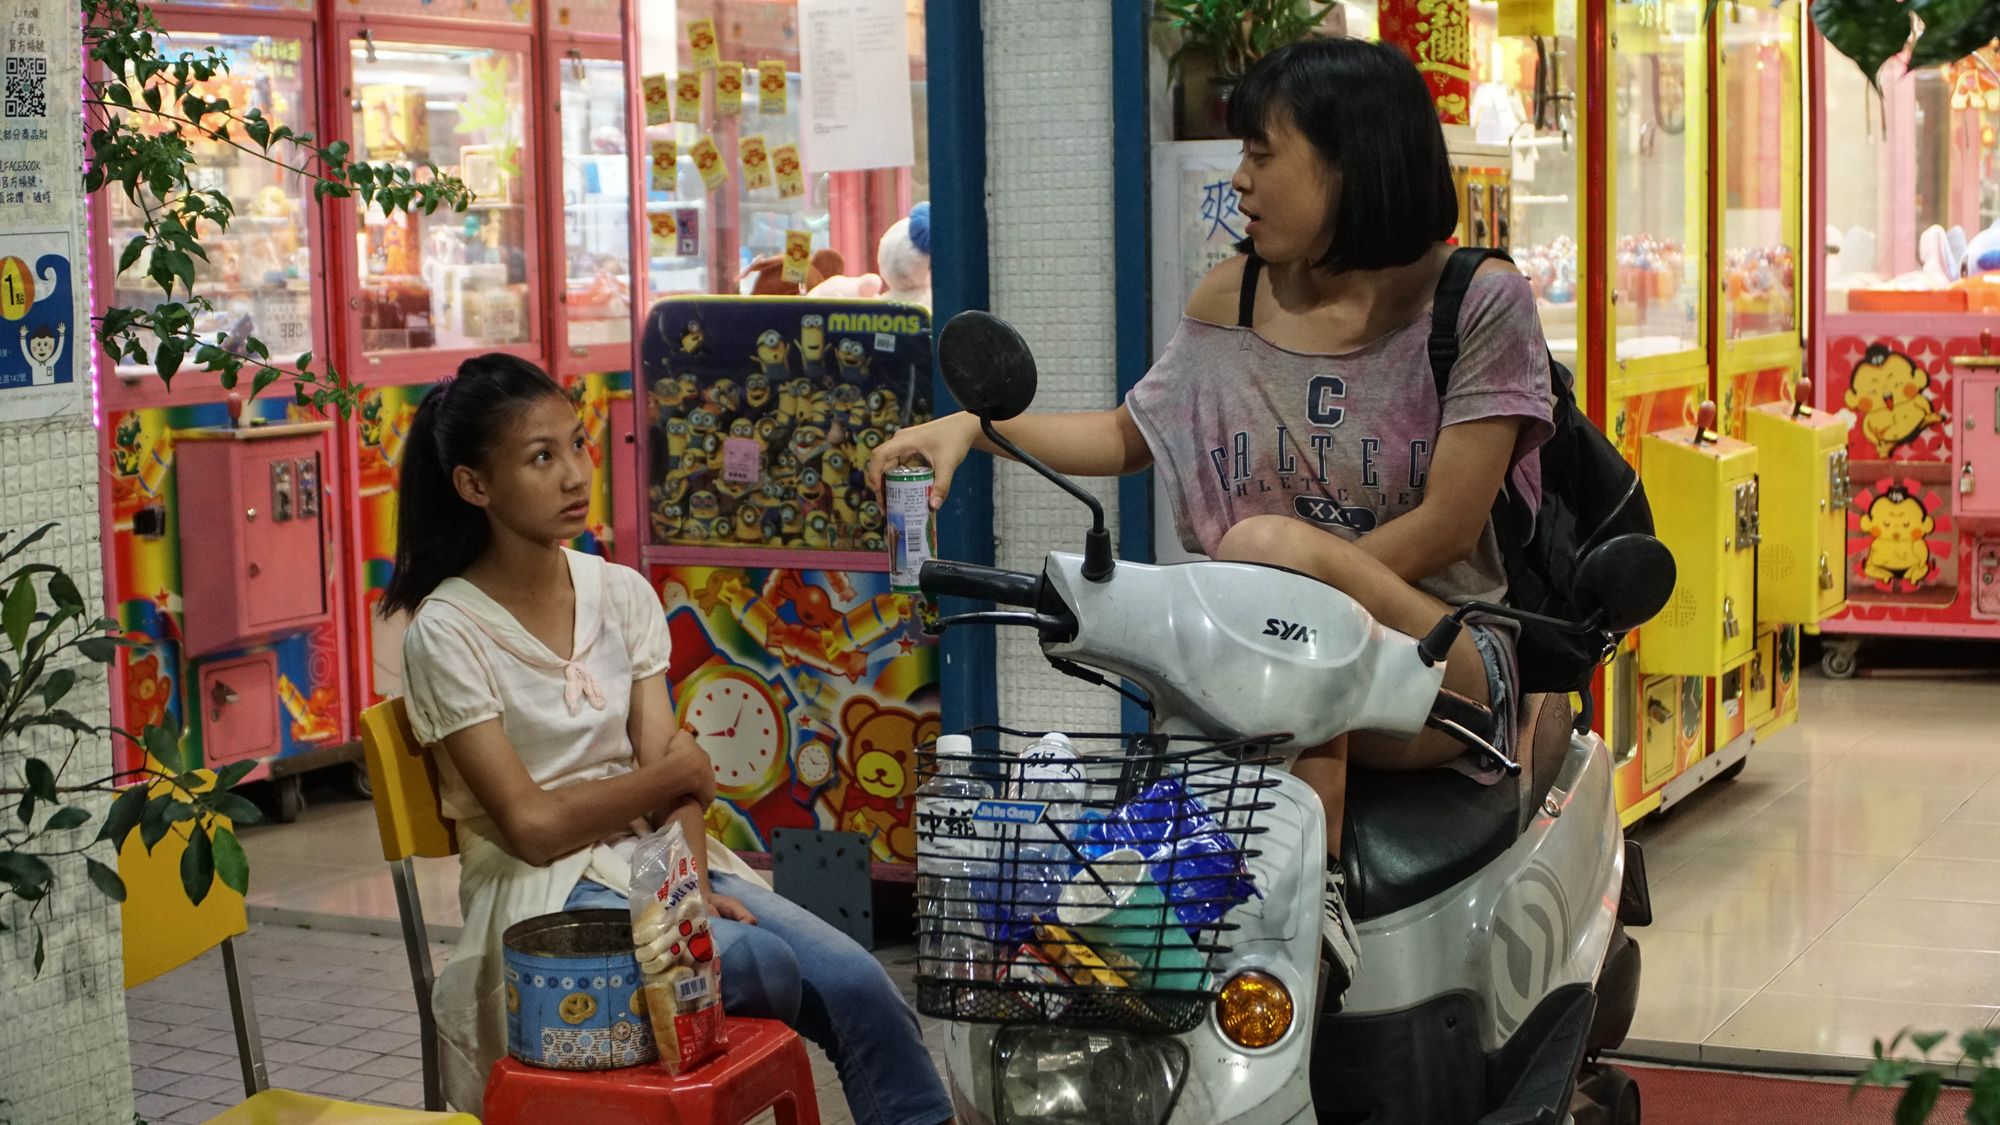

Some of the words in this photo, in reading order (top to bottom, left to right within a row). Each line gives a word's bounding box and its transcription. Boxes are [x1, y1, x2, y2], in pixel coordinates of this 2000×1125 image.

[1201, 180, 1245, 241] 爽
[1306, 374, 1347, 428] C
[1262, 618, 1317, 643] SYM
